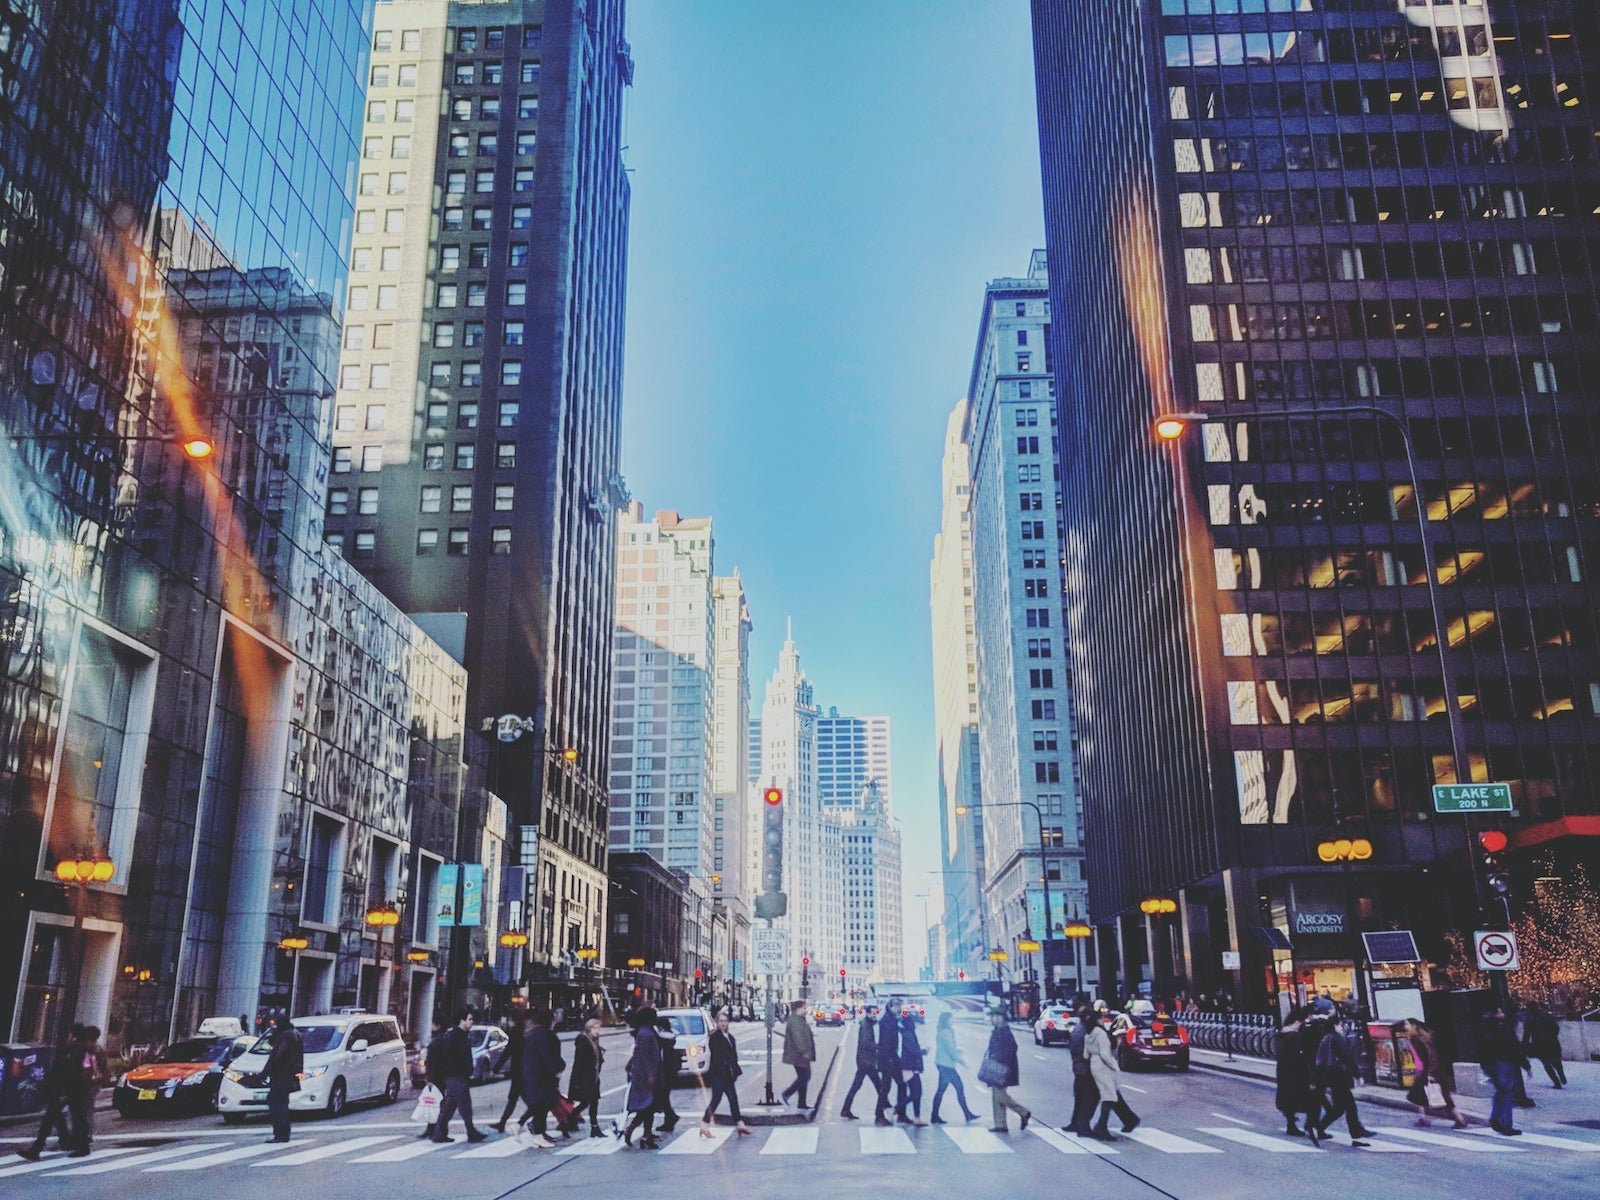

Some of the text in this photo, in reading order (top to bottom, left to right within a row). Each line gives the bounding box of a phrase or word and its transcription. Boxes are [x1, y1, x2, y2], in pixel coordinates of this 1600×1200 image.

[1437, 787, 1505, 799] E LAKE ST
[1459, 799, 1489, 808] 200 N
[1296, 912, 1344, 925] ARGOSY
[1296, 923, 1344, 934] UNIVERSITY
[754, 931, 785, 941] LEFT ON
[757, 941, 782, 951] GREEN
[756, 951, 783, 961] ARROW
